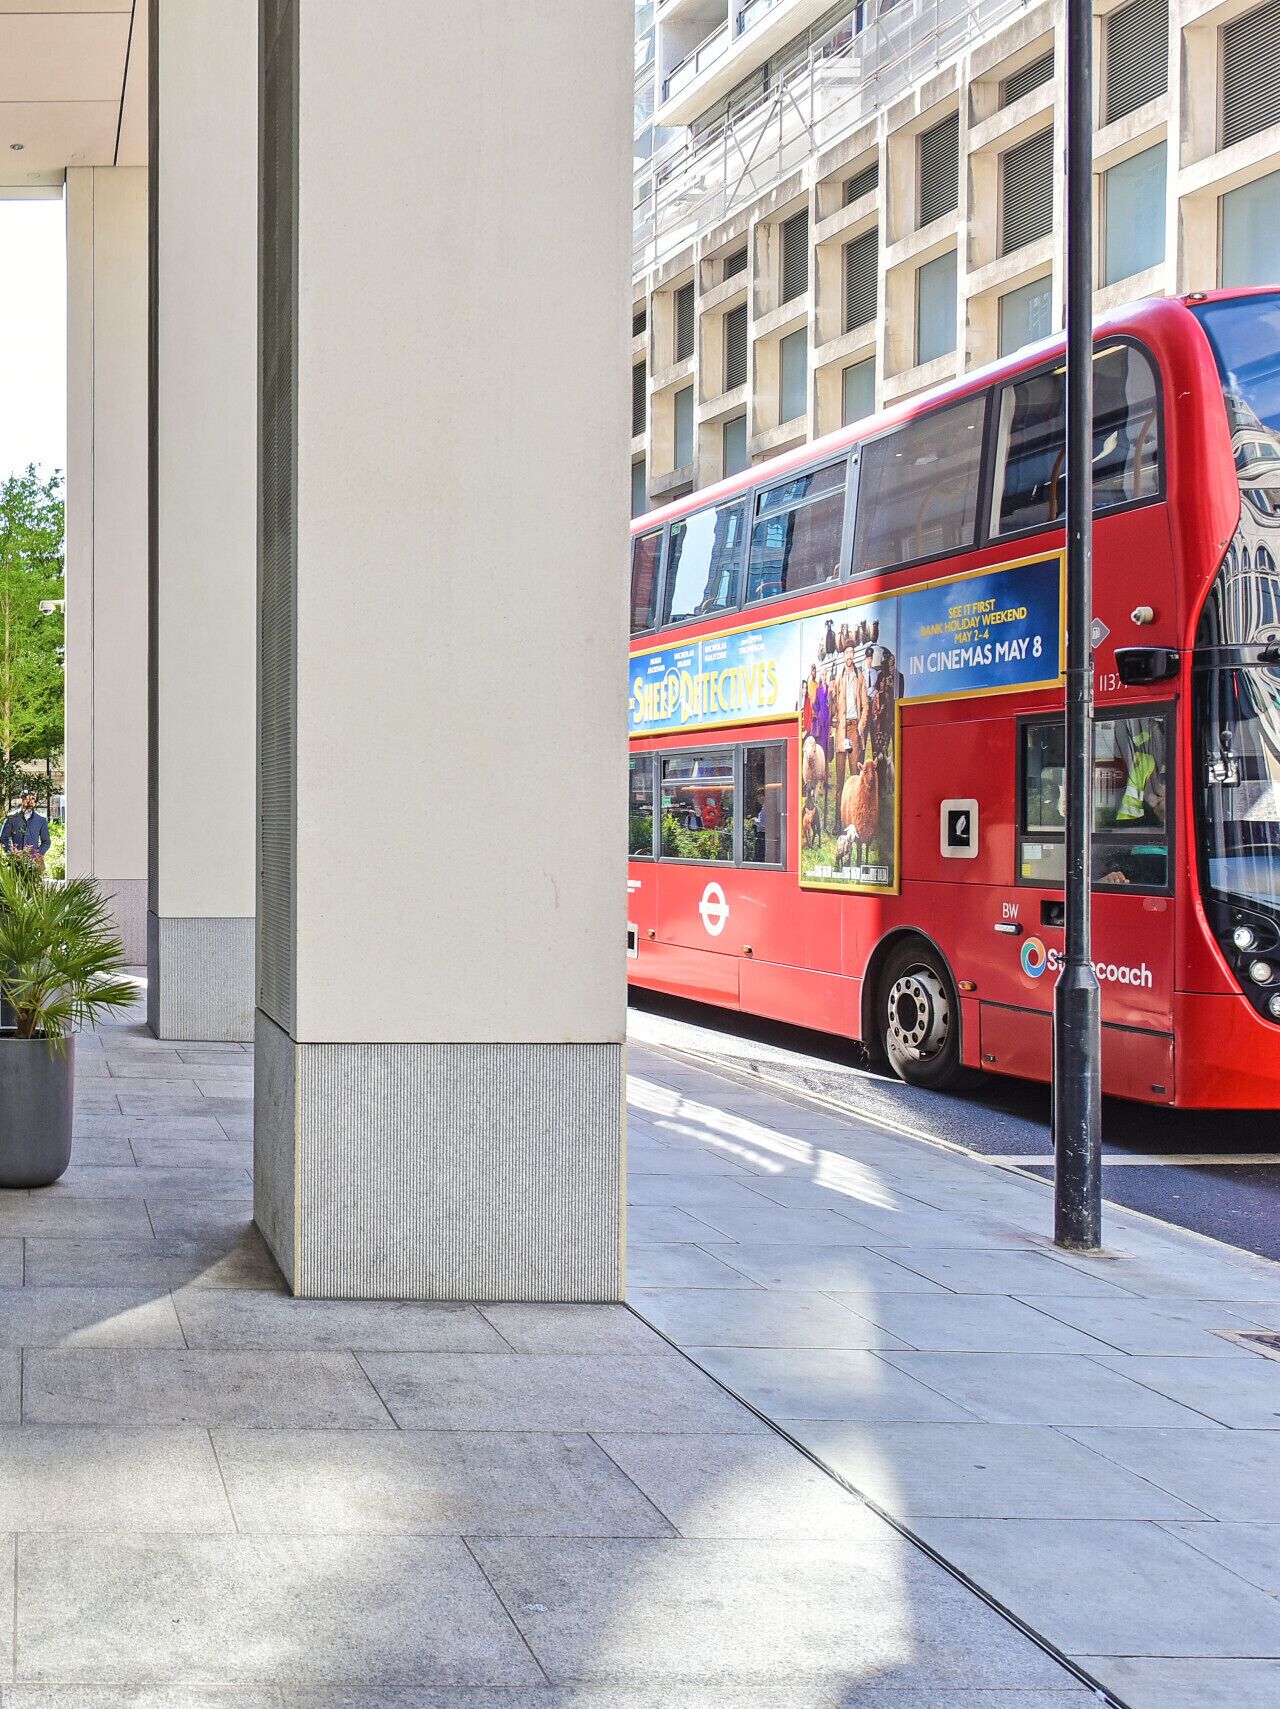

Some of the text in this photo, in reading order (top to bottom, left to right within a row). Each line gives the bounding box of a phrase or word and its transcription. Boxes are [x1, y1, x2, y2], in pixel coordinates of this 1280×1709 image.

[948, 599, 996, 619] SEE IT FIRST
[921, 607, 1027, 638] BANK HOLIDAY WEEKEND
[954, 628, 990, 644] MAY 2-4
[909, 635, 1042, 675] IN CINEMAS MAY 8
[633, 659, 779, 725] SHEEP DETECTIVES
[1100, 673, 1128, 692] 1137
[1002, 902, 1019, 918] BW
